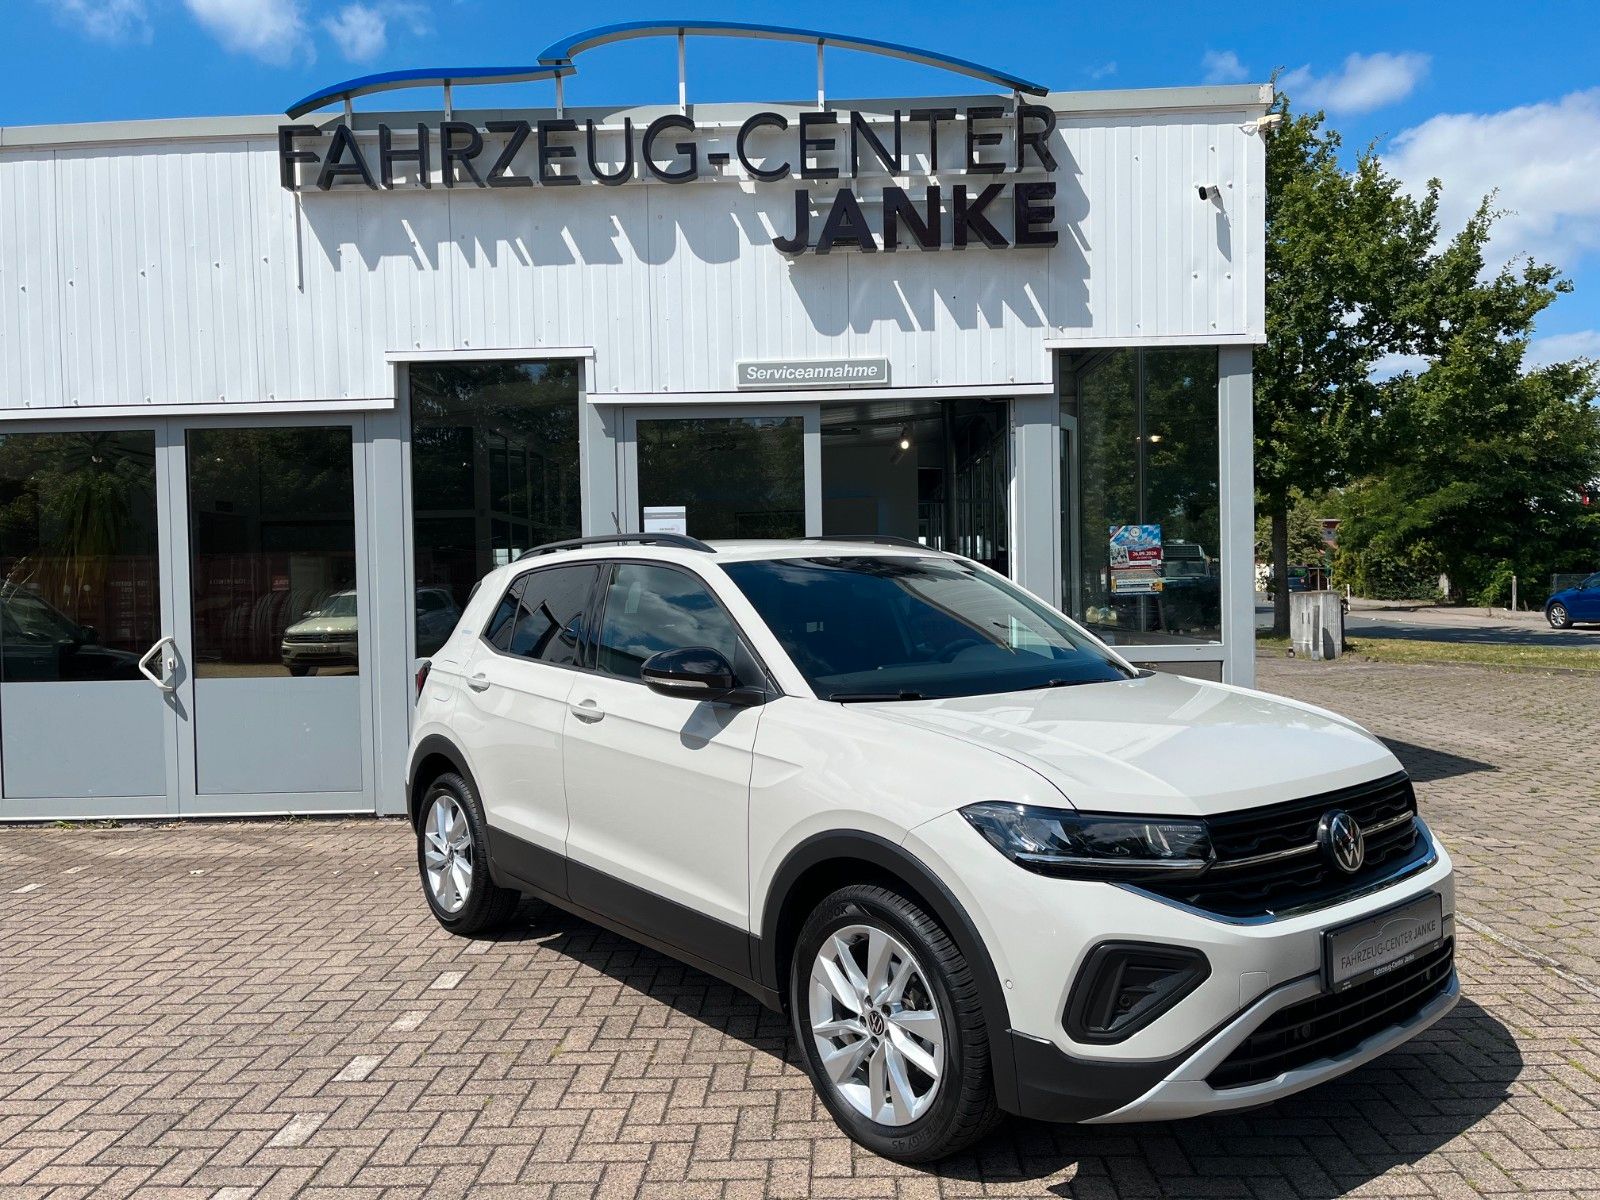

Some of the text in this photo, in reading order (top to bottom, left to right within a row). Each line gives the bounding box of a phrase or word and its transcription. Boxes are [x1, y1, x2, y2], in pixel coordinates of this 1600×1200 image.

[278, 104, 1058, 192] FAHRZEUG-CENTER
[772, 182, 1058, 255] JANKE
[747, 363, 877, 380] Serviceannahme
[1341, 920, 1436, 969] FAHRZEUG-CENTER JANKE
